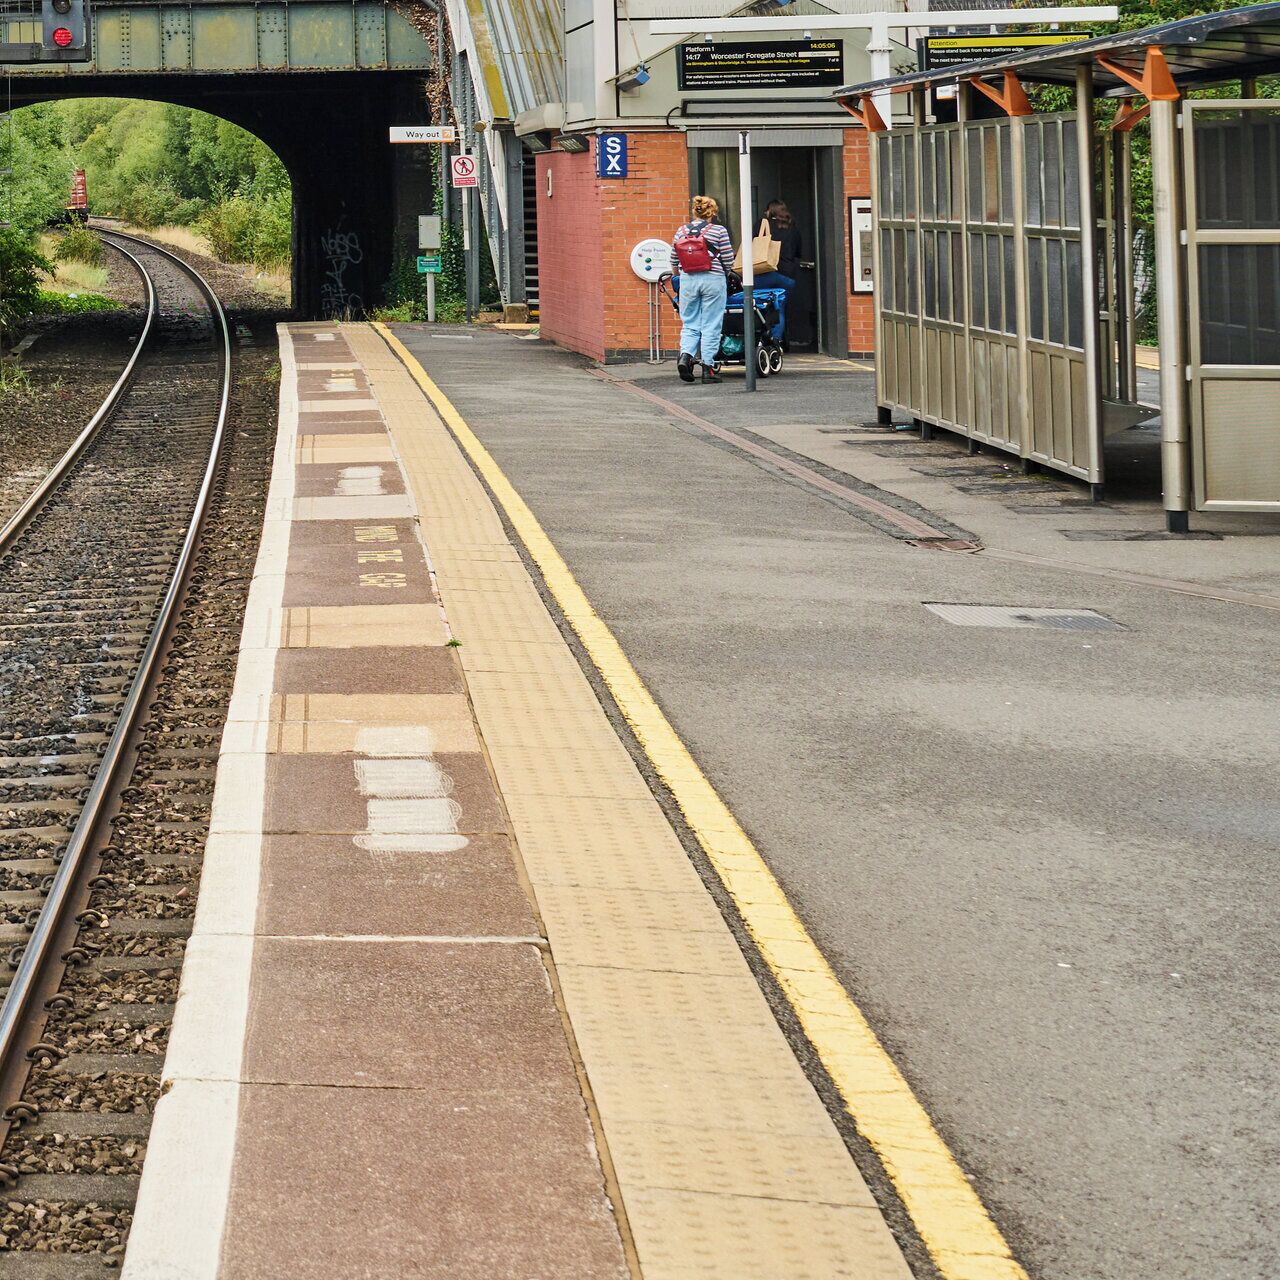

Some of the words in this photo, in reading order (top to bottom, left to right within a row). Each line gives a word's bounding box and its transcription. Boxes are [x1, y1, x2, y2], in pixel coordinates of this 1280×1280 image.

[746, 52, 776, 60] Foregate
[405, 131, 424, 140] Way
[606, 136, 621, 154] S
[606, 154, 622, 171] X
[357, 548, 404, 564] THE
